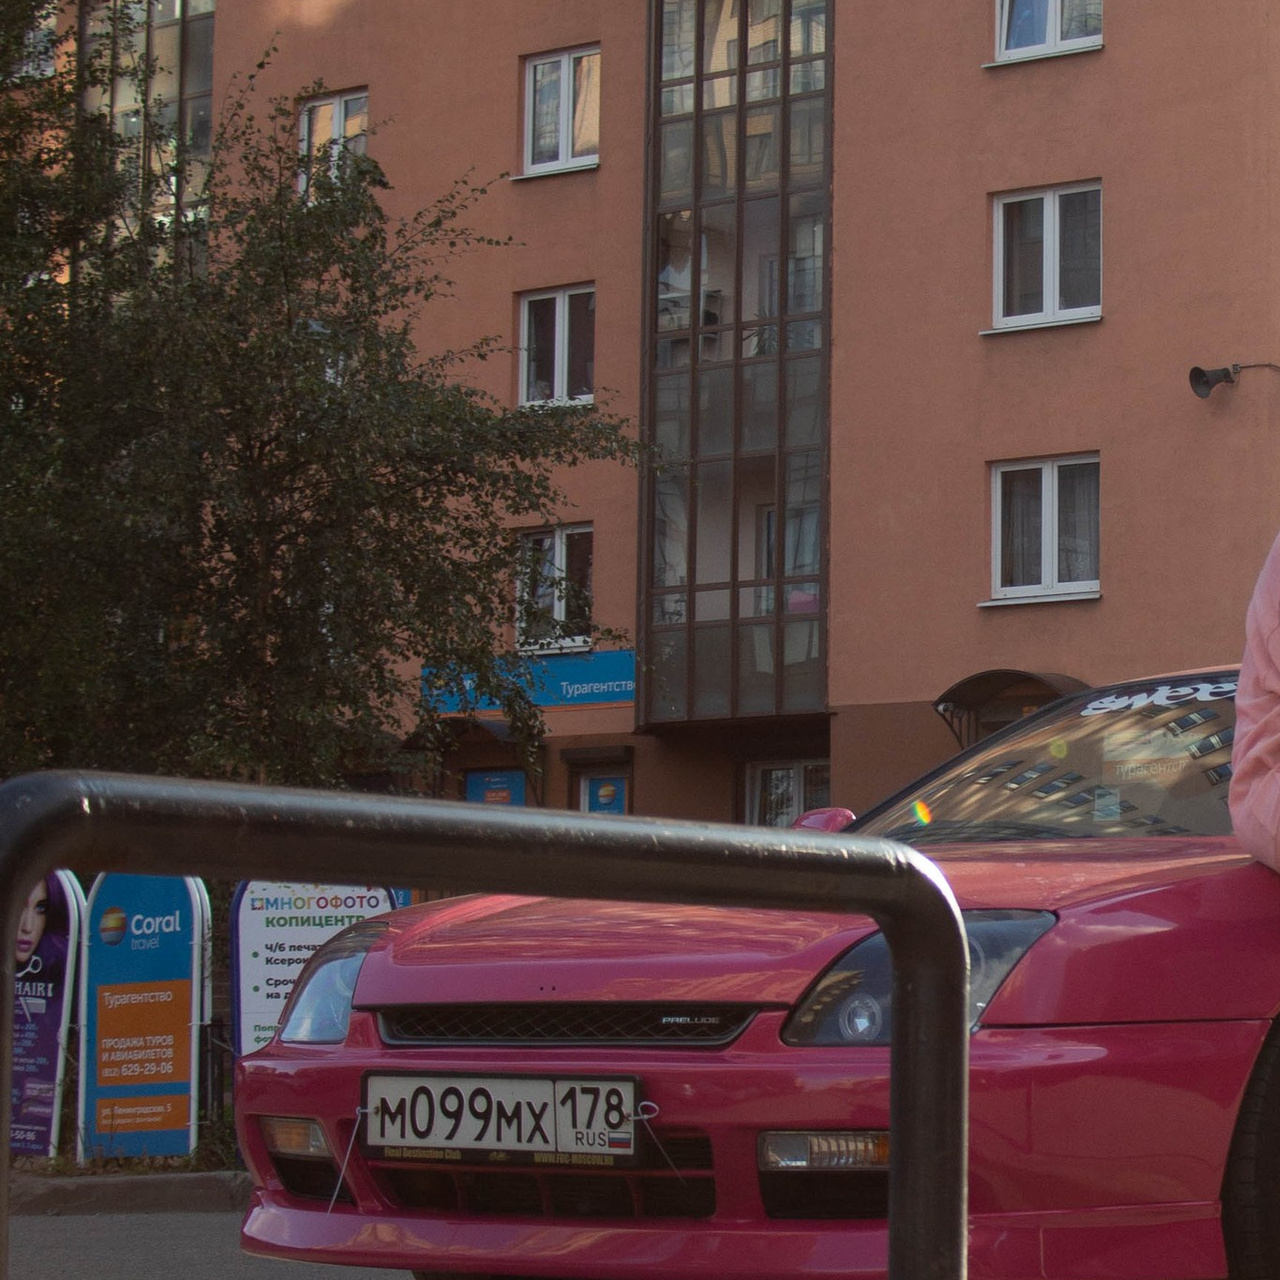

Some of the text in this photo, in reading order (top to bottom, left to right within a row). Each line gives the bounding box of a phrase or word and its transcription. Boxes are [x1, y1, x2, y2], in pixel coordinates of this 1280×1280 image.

[265, 895, 380, 911] МНОГОФОТО
[131, 910, 181, 935] Coral
[131, 935, 160, 951] travel
[103, 991, 173, 1008] Турагентство
[662, 1016, 721, 1024] PRELUDE
[101, 1035, 174, 1050] ПРОДАЖА ТУРОВ
[101, 1048, 174, 1062] И АВИАБИЛЕТОВ
[121, 1061, 174, 1076] 629-29-06
[560, 1086, 625, 1130] 178
[575, 1131, 607, 1147] RUS
